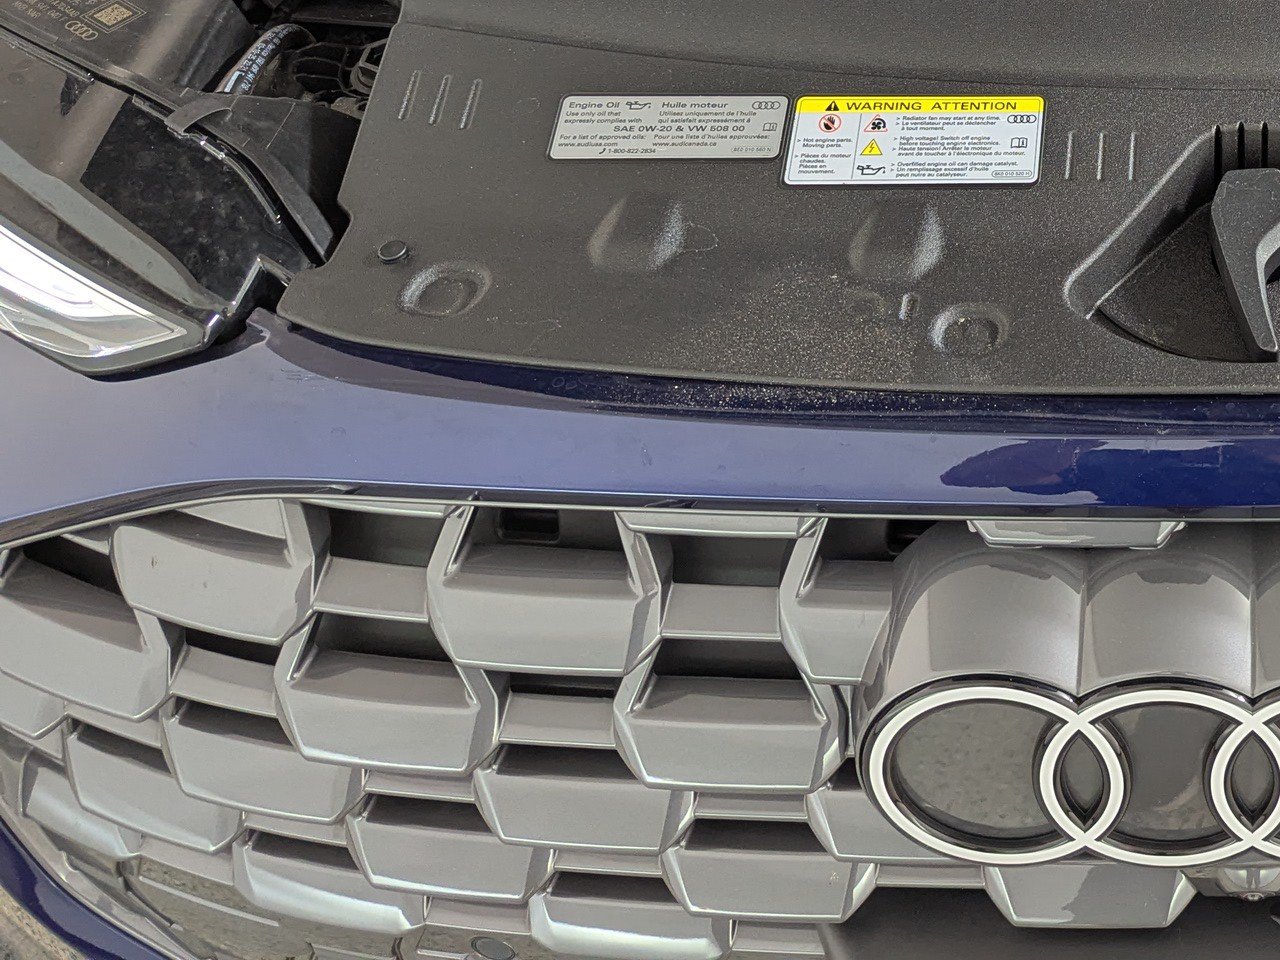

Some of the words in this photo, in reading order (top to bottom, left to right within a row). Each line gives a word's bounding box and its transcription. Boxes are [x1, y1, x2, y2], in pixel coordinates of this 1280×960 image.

[569, 101, 602, 109] Engine
[847, 102, 922, 110] WARNING
[931, 102, 1017, 110] ATTENTION
